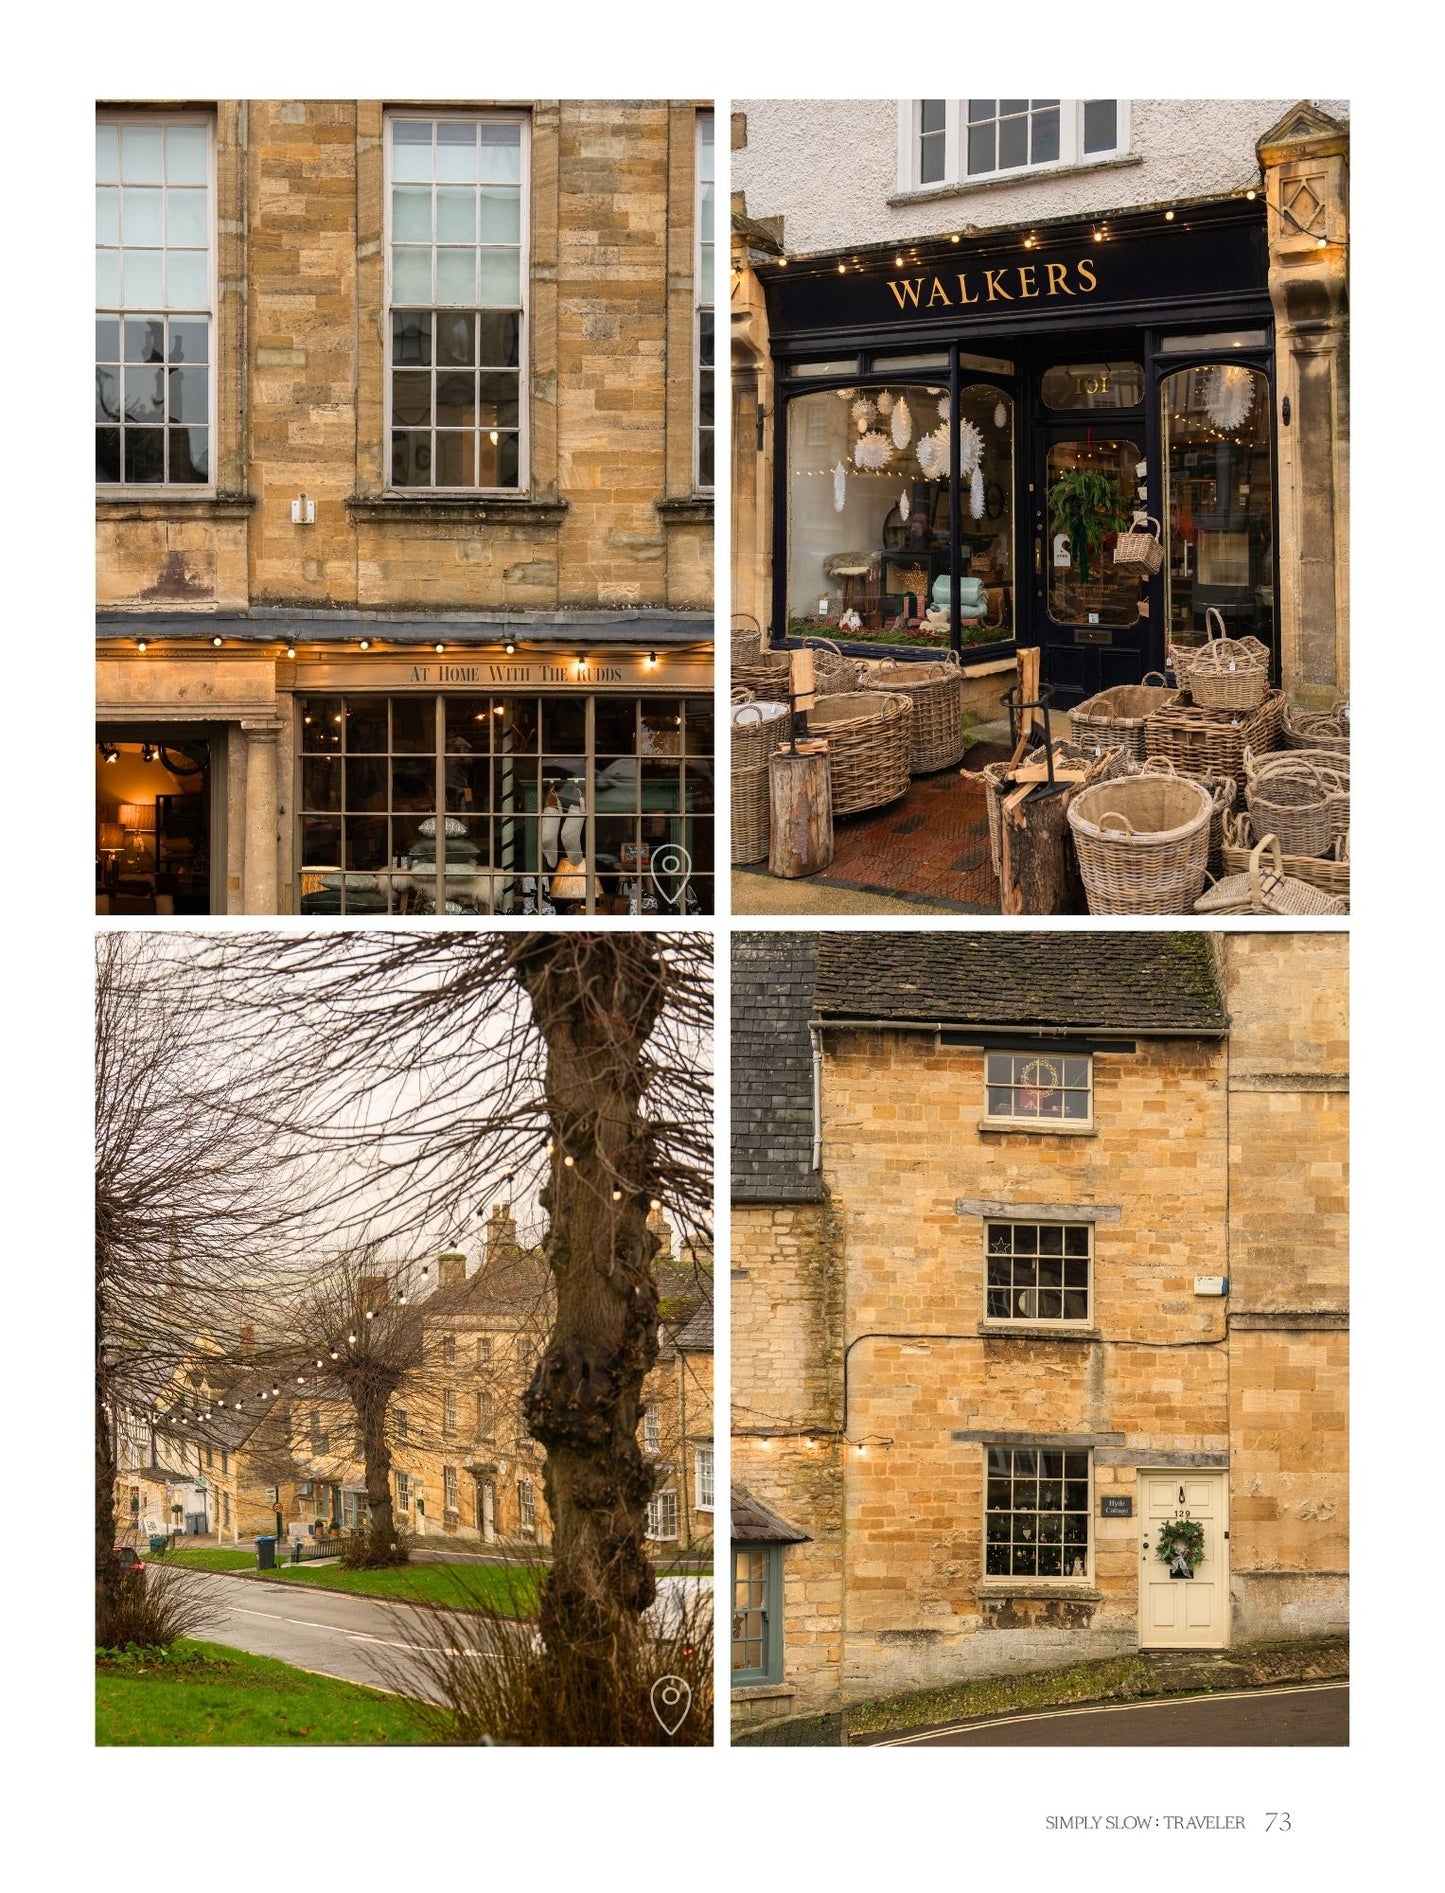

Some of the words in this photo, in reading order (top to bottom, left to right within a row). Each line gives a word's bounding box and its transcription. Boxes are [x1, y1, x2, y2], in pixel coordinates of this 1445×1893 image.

[886, 259, 1097, 310] WALKERS
[1109, 1499, 1125, 1508] Hyde
[1105, 1508, 1129, 1516] Cottage
[1174, 1510, 1191, 1518] 129
